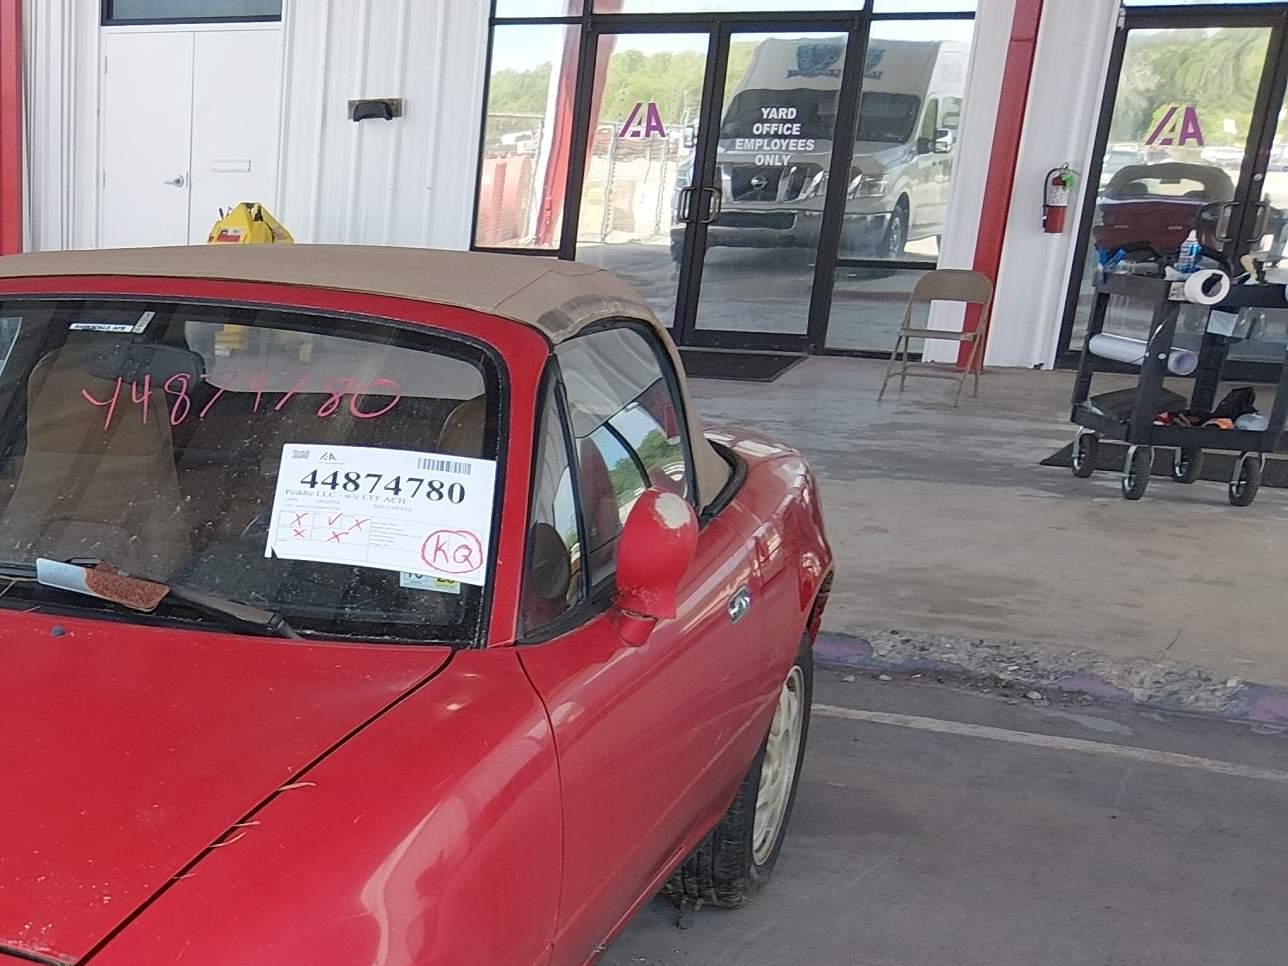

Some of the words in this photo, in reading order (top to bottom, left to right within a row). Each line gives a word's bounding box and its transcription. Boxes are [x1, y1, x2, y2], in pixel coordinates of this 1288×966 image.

[761, 107, 797, 120] YARD
[752, 123, 801, 135] OFFICE
[735, 138, 815, 151] EMPLOYEES
[754, 154, 791, 166] ONLY
[300, 468, 466, 505] 44874780
